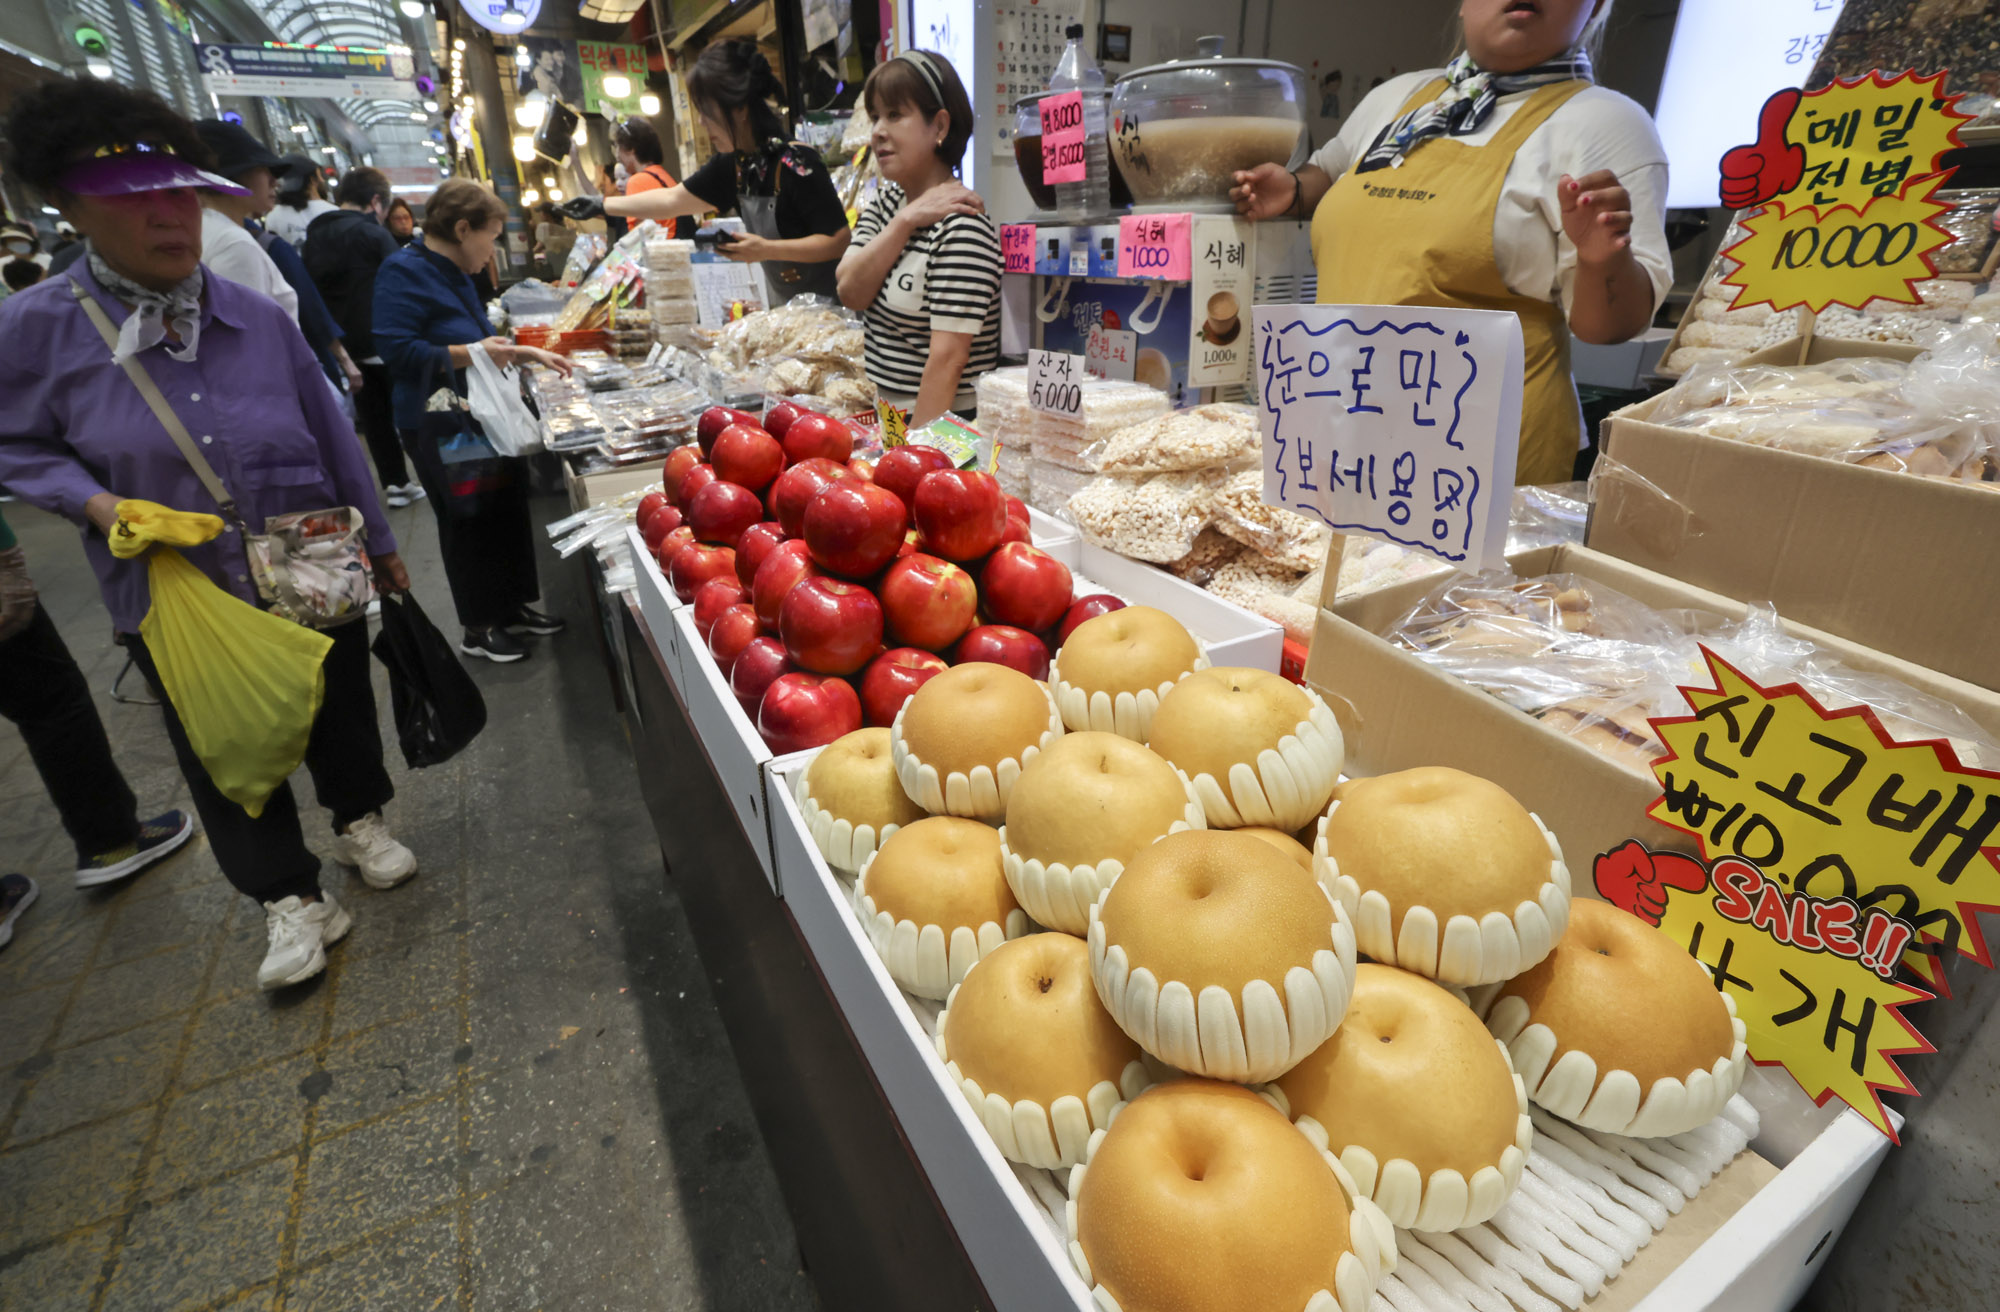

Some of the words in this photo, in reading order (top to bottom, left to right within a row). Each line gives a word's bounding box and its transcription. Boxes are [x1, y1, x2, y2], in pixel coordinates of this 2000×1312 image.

[1804, 155, 1914, 206] 전병
[1135, 219, 1166, 244] 식혜
[1204, 240, 1245, 270] 식혜
[898, 273, 914, 291] G
[1038, 352, 1073, 382] 산자
[1275, 338, 1441, 427] 눈으로만
[1694, 695, 2000, 885] 신고배
